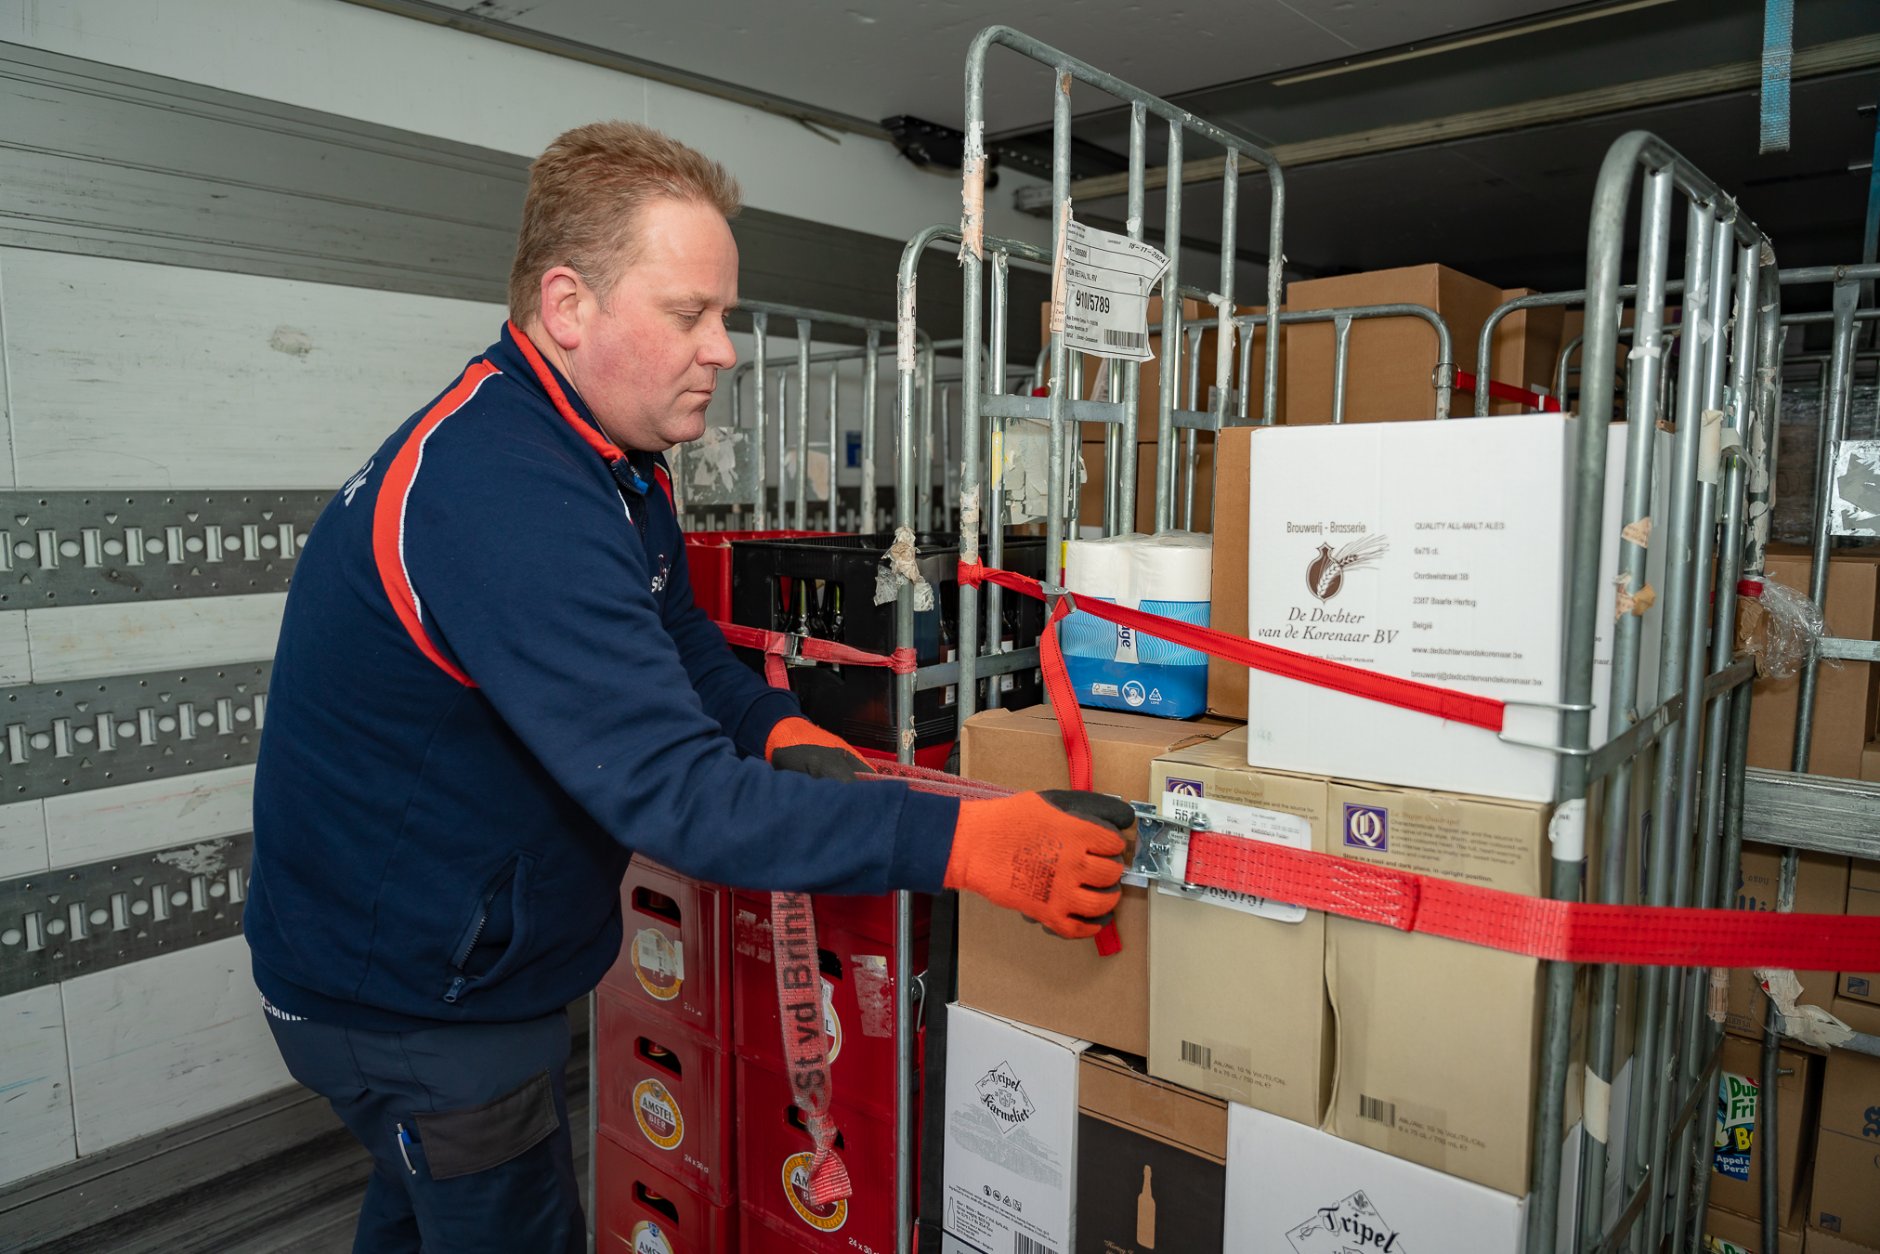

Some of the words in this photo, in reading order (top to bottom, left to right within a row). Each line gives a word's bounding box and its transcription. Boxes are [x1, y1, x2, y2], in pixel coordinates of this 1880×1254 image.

[1286, 521, 1323, 535] Brouwerij
[1330, 522, 1366, 533] Brasserie
[1414, 522, 1446, 530] QUALITY
[1484, 522, 1505, 530] ALES
[1288, 607, 1307, 622] De
[1310, 608, 1365, 624] Dochter
[1258, 628, 1281, 638] van
[1285, 624, 1299, 639] de
[1302, 626, 1370, 643] Korenaar
[1373, 629, 1399, 644] BV
[1350, 809, 1382, 847] Q
[987, 1067, 1021, 1092] Tripel
[642, 1096, 674, 1123] AMSTEL
[981, 1093, 1031, 1123] Karmeliet
[1731, 1098, 1755, 1120] Fri
[649, 1114, 667, 1130] BIER
[1716, 1154, 1744, 1165] Appel
[1723, 1164, 1749, 1174] Perzi
[1317, 1203, 1400, 1254] Tripel
[848, 1236, 857, 1246] 24
